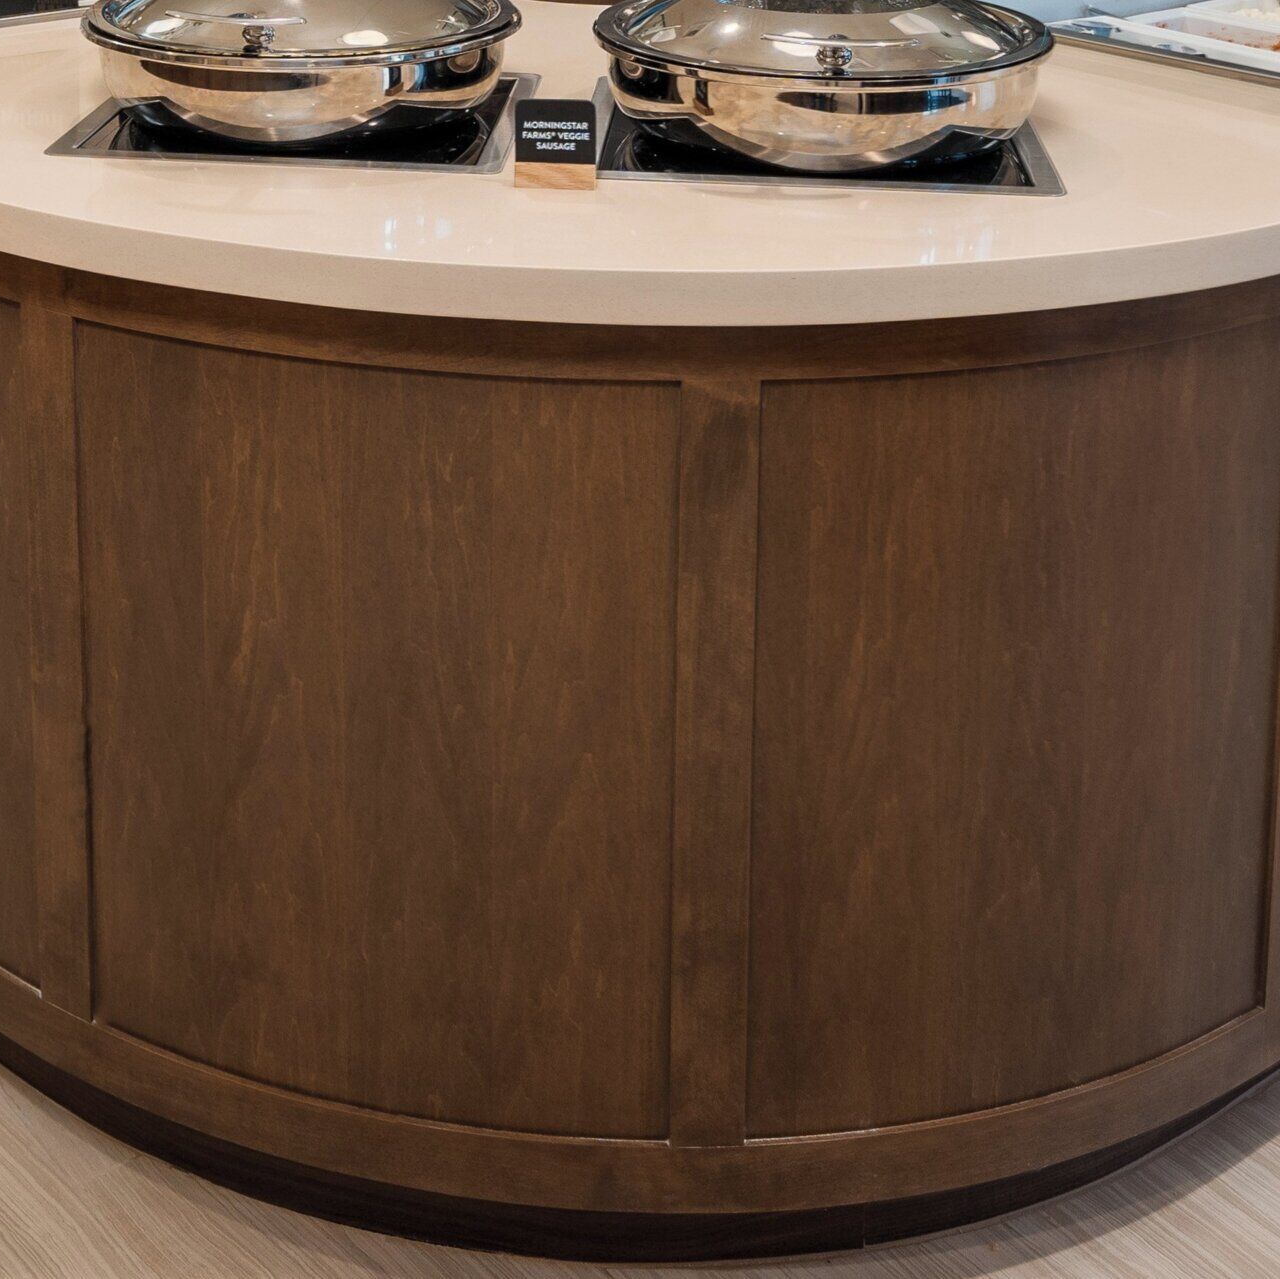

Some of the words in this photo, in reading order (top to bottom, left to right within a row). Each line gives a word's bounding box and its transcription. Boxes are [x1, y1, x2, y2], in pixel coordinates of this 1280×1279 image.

[523, 121, 589, 130] MORNINGSTAR
[557, 132, 591, 141] VEGGIE
[536, 141, 577, 151] SAUSAGE
